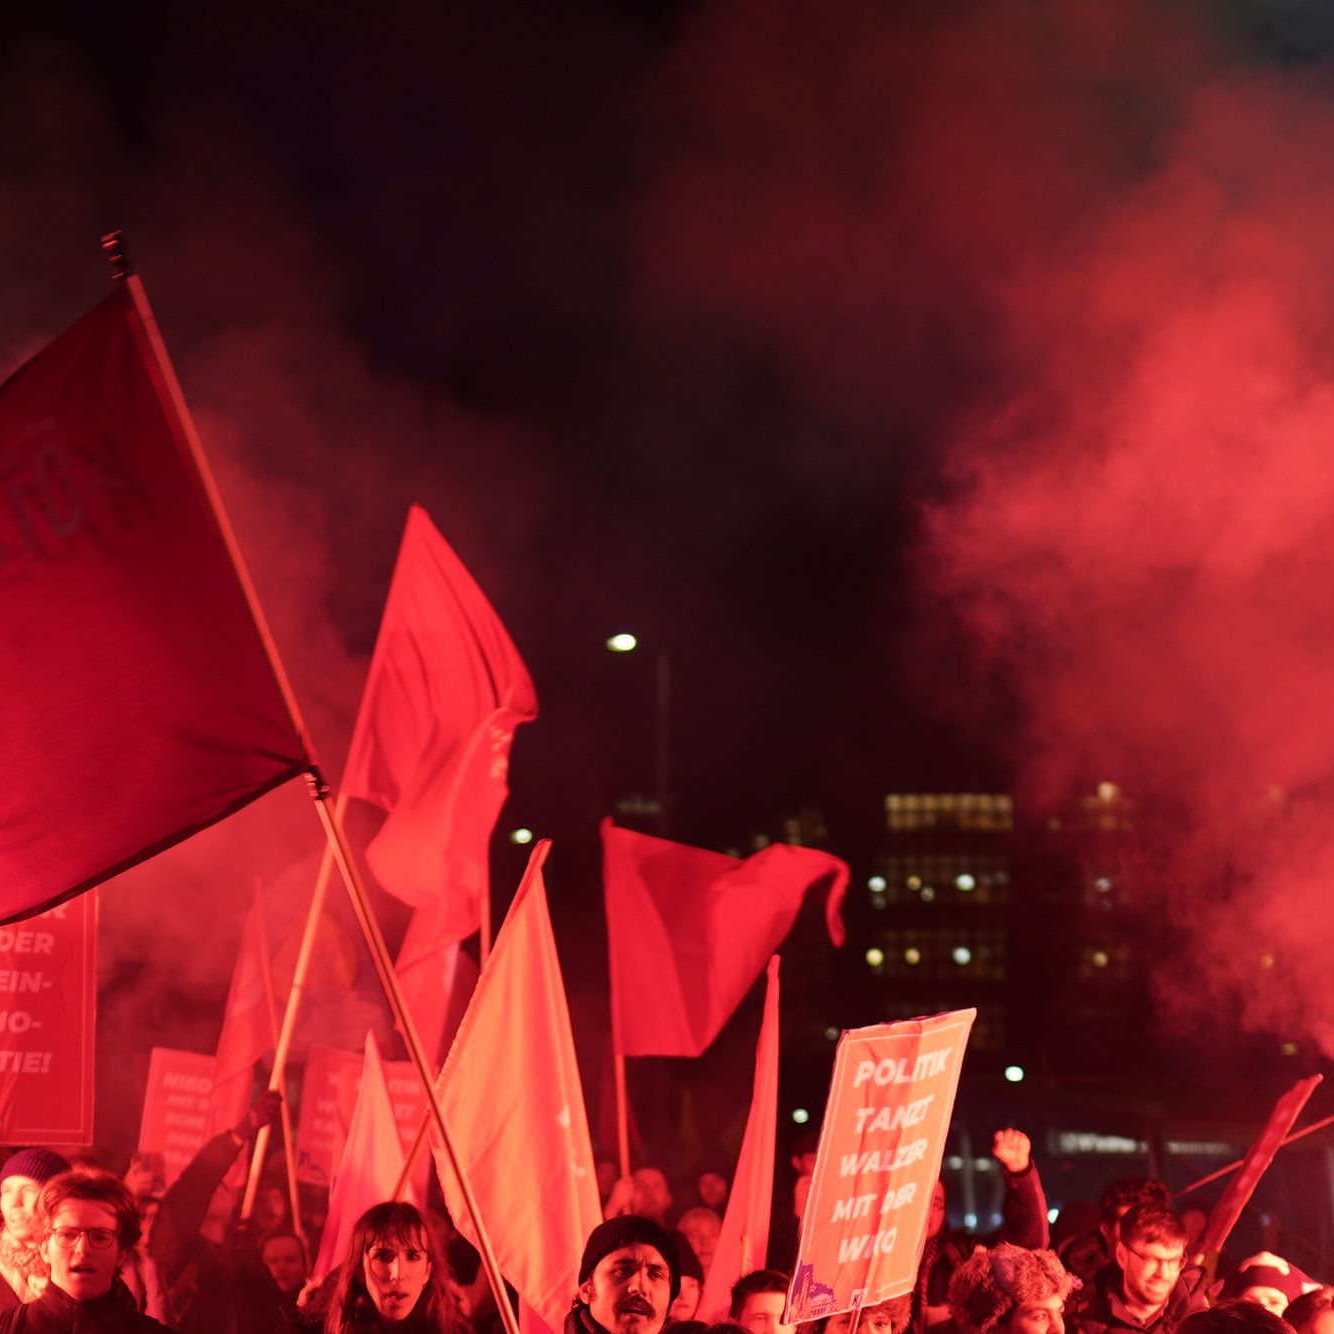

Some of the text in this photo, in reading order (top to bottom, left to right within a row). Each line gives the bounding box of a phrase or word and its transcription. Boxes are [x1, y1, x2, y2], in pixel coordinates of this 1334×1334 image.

[853, 1046, 953, 1088] POLITIK
[855, 1094, 934, 1134] TANZT
[839, 1137, 928, 1178] WALZER
[831, 1182, 917, 1224] MIT DER
